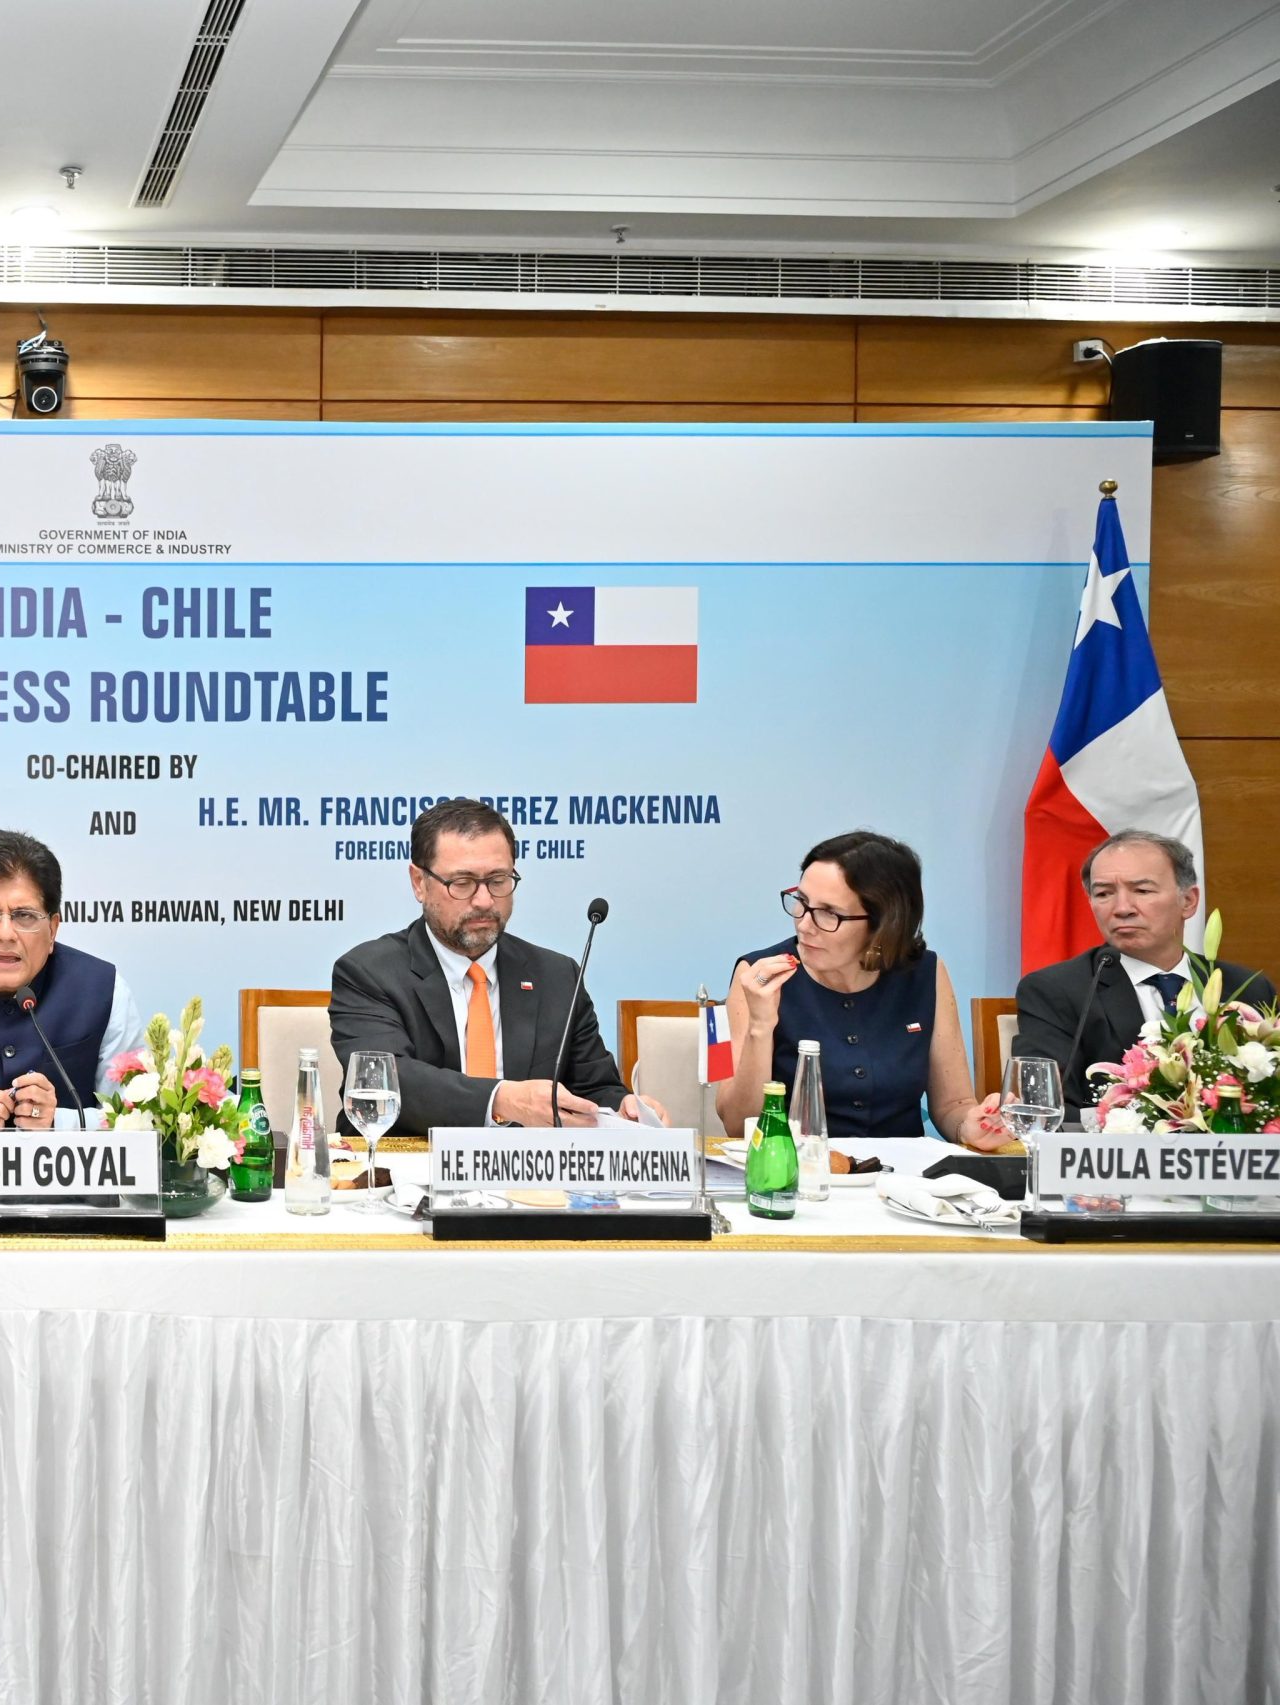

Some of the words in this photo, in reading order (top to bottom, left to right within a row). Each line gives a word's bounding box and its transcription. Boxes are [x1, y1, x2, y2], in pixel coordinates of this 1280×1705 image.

[38, 529, 129, 541] GOVERNMENT
[132, 529, 150, 541] OF
[153, 530, 188, 541] INDIA
[56, 543, 74, 554] OF
[77, 543, 152, 555] COMMERCE
[155, 544, 165, 555] &
[168, 544, 232, 555] INDUSTRY
[142, 586, 272, 639] CHILE
[90, 670, 389, 724] ROUNDTABLE
[27, 754, 161, 780] CO-CHAIRED
[169, 754, 198, 779] BY
[89, 810, 137, 836] AND
[199, 797, 248, 827] H.E.
[258, 797, 310, 826] MR.
[569, 794, 721, 825] MACKENNA
[335, 840, 410, 861] FOREIGN
[536, 839, 585, 860] CHILE
[131, 899, 226, 926] BHAWAN,
[233, 899, 282, 922] NEW
[288, 899, 344, 922] DELHI
[32, 1145, 136, 1187] GOYAL
[441, 1149, 469, 1181] H.E.
[473, 1149, 555, 1182] FRANCISCO
[559, 1142, 605, 1182] PÉREZ
[609, 1150, 691, 1182] MACKENNA
[1060, 1147, 1151, 1180] PAULA
[1159, 1140, 1280, 1181] ESTÉVEZ
